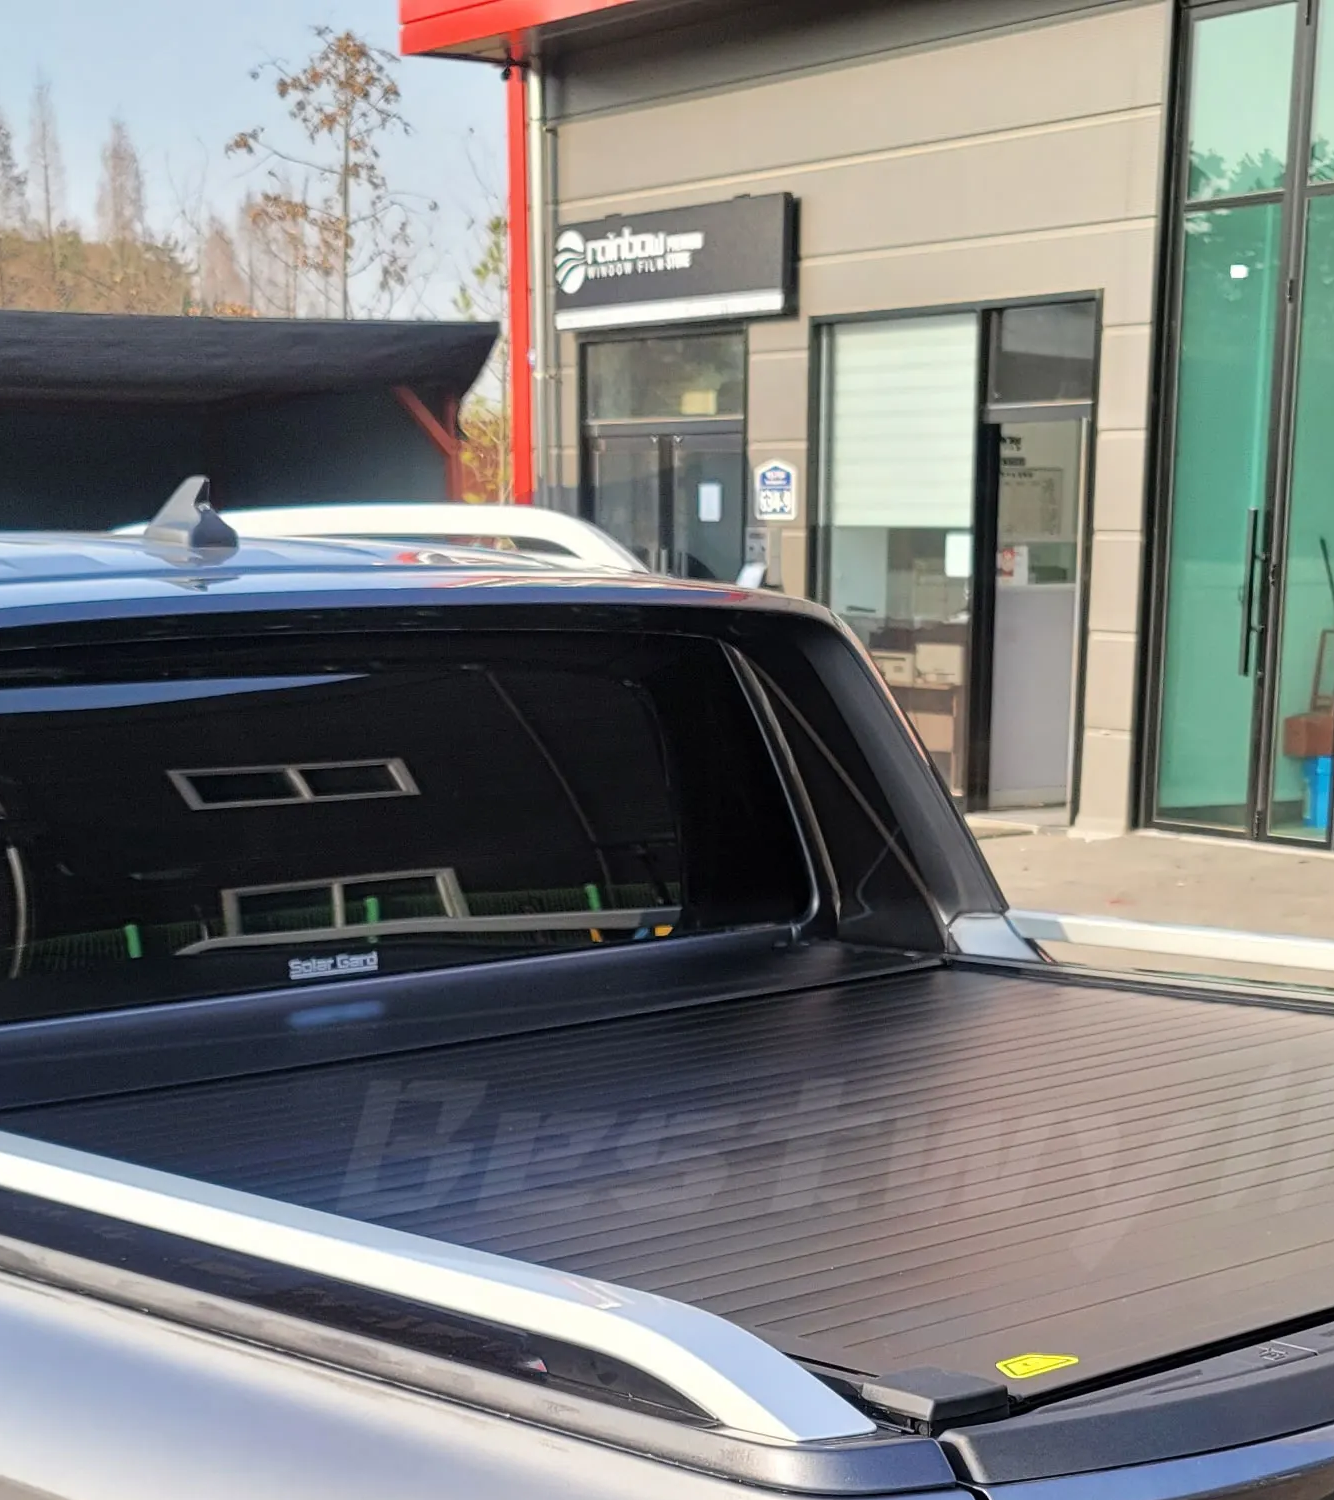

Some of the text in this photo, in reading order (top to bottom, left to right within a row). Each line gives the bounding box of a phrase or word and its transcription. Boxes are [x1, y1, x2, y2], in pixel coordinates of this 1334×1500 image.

[586, 226, 666, 265] rainbow
[587, 261, 633, 280] WINDOW
[637, 257, 664, 274] FILM
[288, 950, 379, 976] Solar Gard
